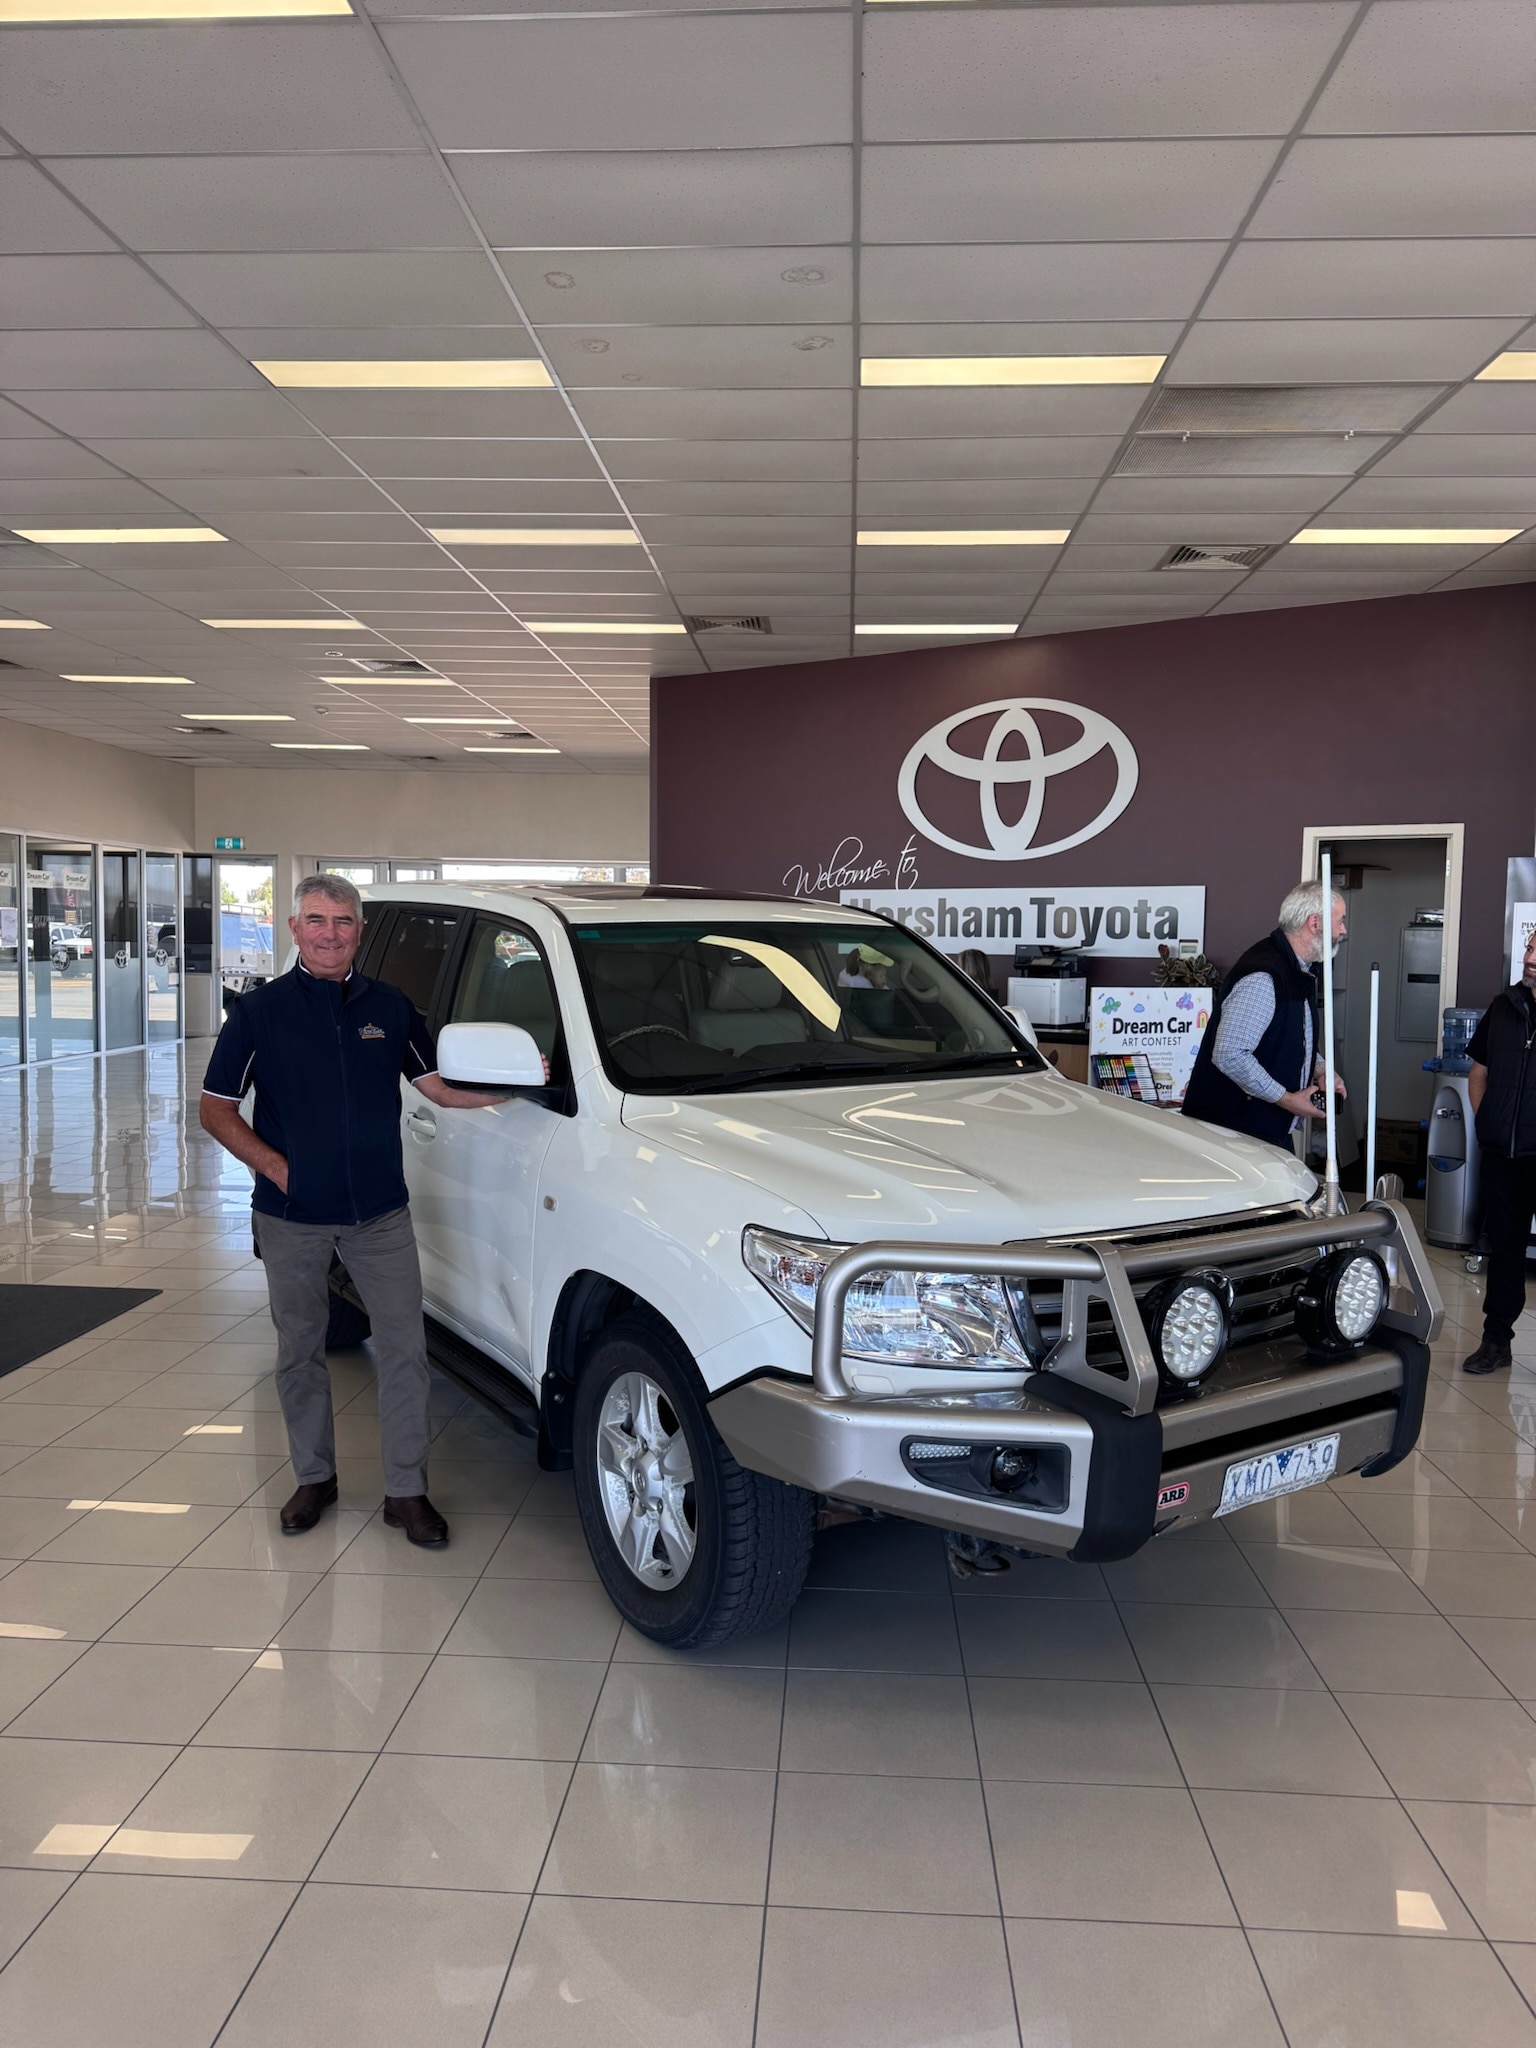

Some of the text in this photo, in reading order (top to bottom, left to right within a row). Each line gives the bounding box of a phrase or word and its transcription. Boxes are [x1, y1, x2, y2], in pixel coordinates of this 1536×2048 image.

[783, 834, 918, 896] Welcome to
[850, 896, 1179, 946] rsham Toyota
[1112, 1016, 1193, 1035] Dream Car
[1122, 1036, 1182, 1047] ART CONTEST
[1159, 1487, 1186, 1505] ARB
